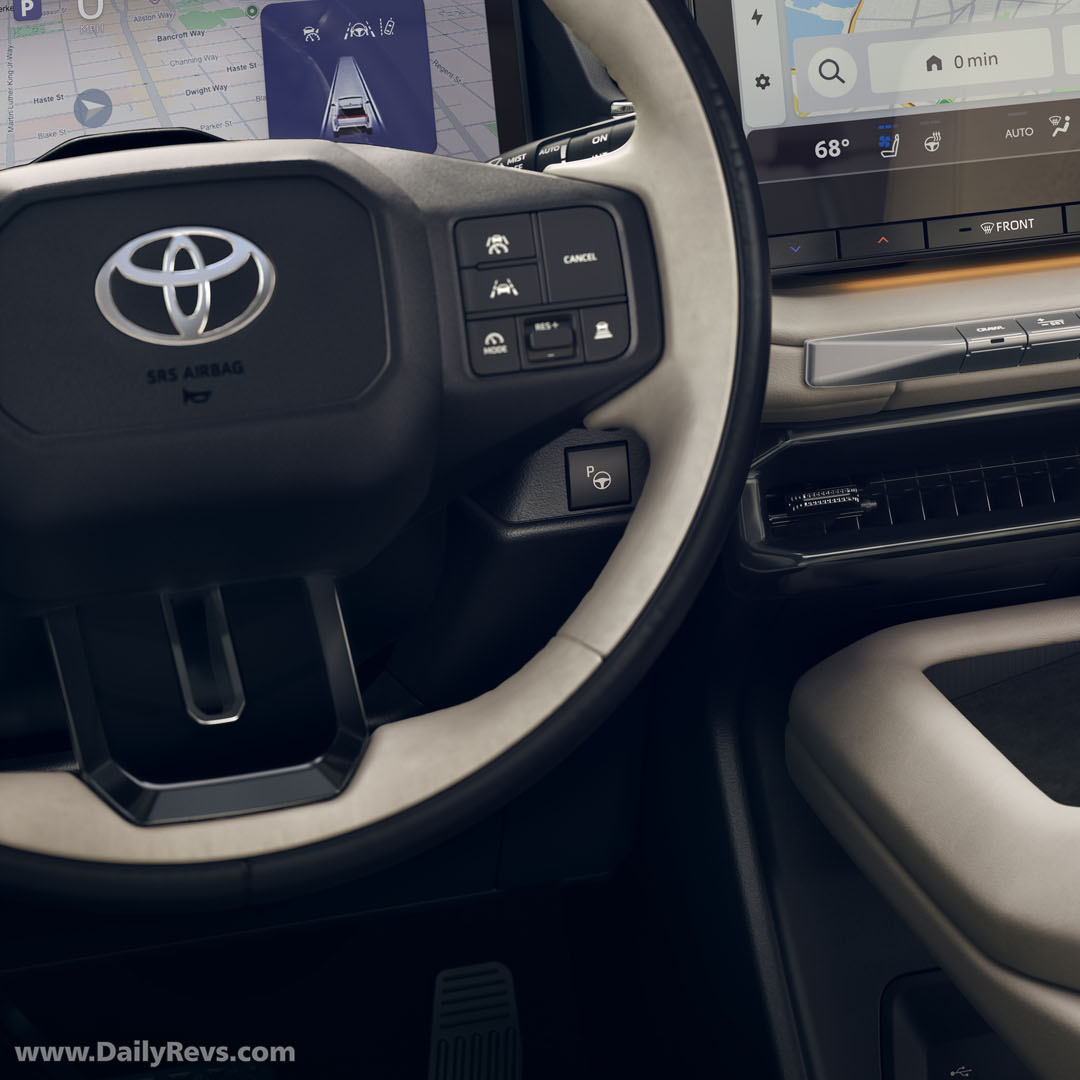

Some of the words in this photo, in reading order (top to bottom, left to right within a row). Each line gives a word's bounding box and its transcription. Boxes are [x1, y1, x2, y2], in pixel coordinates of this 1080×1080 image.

[21, 0, 34, 17] P
[157, 11, 173, 19] Way
[157, 33, 188, 42] Bancroft
[189, 29, 206, 38] Way
[169, 57, 202, 67] Channing
[203, 54, 218, 63] Way
[954, 55, 963, 69] 0
[967, 52, 998, 67] min
[226, 65, 247, 73] Haste
[185, 87, 211, 96] Dwight
[211, 84, 228, 92] Way
[592, 134, 608, 144] ON
[1005, 127, 1034, 139] AUTO
[539, 145, 560, 155] AUTO
[814, 138, 850, 159] 68°
[507, 153, 527, 165] MIST
[996, 218, 1034, 232] FRONT
[563, 252, 598, 264] CANCEL
[483, 345, 508, 355] MODE
[146, 367, 178, 384] SRS
[183, 360, 244, 379] AIRBAG
[586, 465, 595, 478] P
